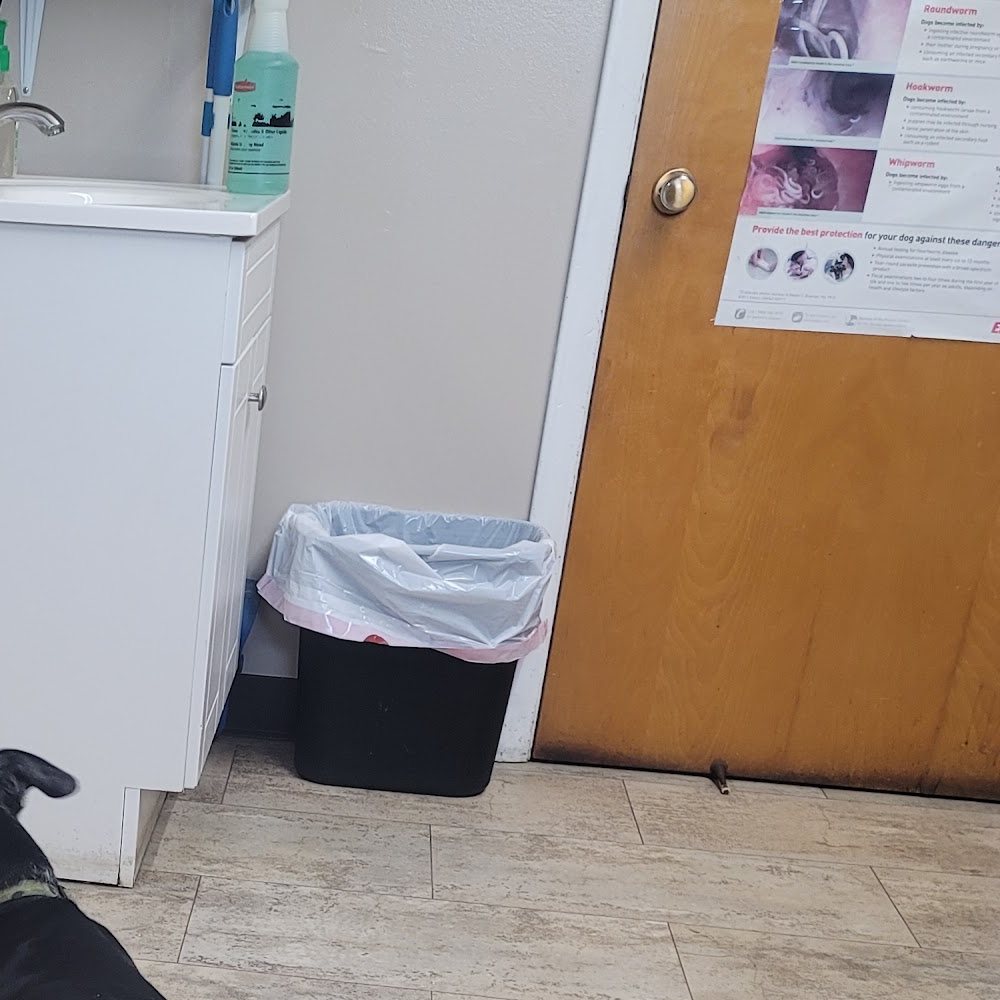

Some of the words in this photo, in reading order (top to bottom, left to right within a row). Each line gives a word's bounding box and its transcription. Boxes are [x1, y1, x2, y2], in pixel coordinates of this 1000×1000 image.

[923, 4, 978, 16] Roundworm
[906, 82, 953, 93] Hookworm
[889, 158, 935, 168] Whipworm
[752, 225, 784, 234] Provide
[801, 228, 819, 237] best
[820, 230, 862, 238] protection
[864, 232, 877, 240] for
[878, 233, 897, 242] your
[899, 234, 914, 243] dog
[916, 235, 946, 244] against
[947, 236, 970, 246] these
